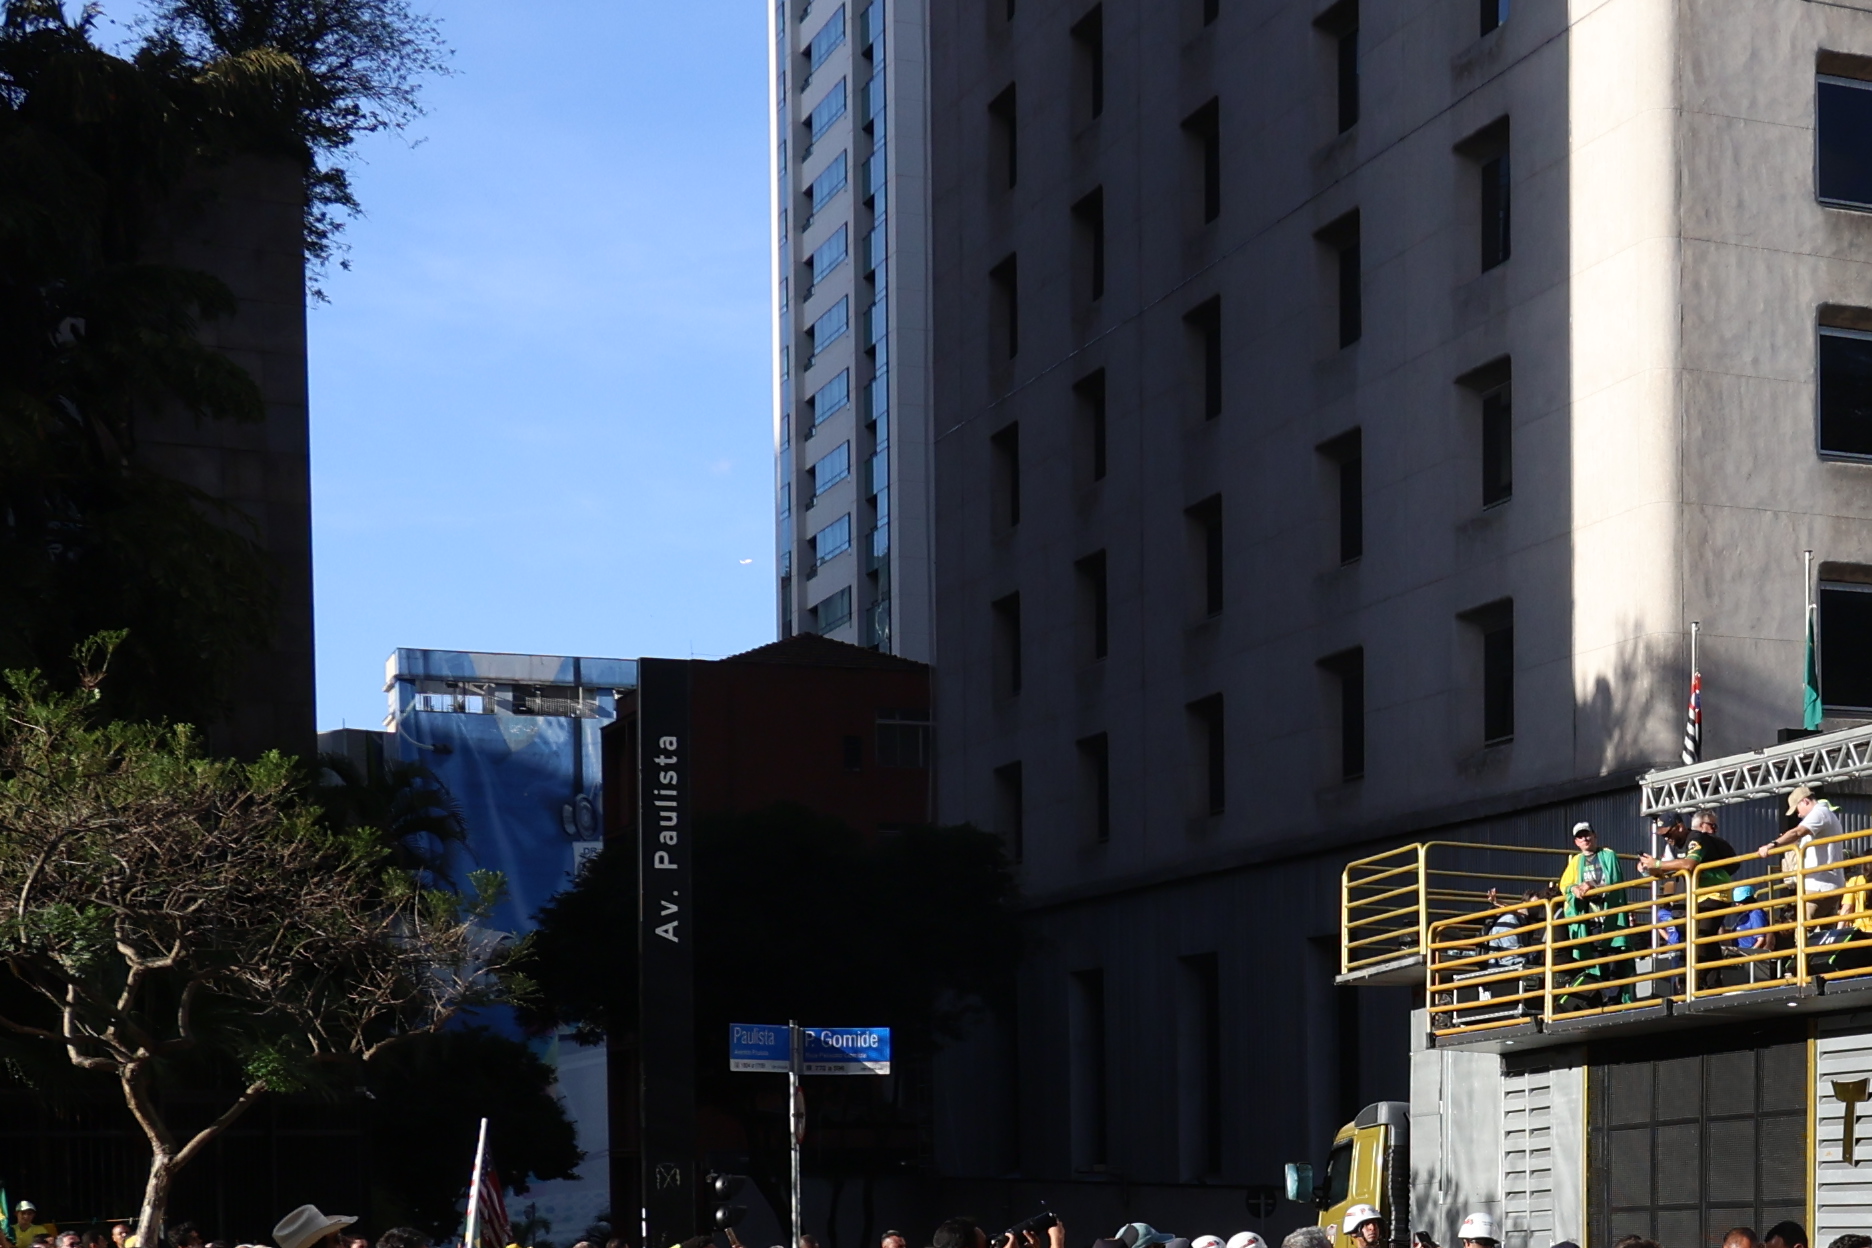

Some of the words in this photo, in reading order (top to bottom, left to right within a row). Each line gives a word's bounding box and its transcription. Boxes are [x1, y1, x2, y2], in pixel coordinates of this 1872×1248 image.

[653, 735, 678, 870] Paulista
[655, 890, 679, 944] Av.
[733, 1026, 775, 1046] Paulista
[805, 1030, 816, 1047] P.
[821, 1030, 879, 1048] Gomide
